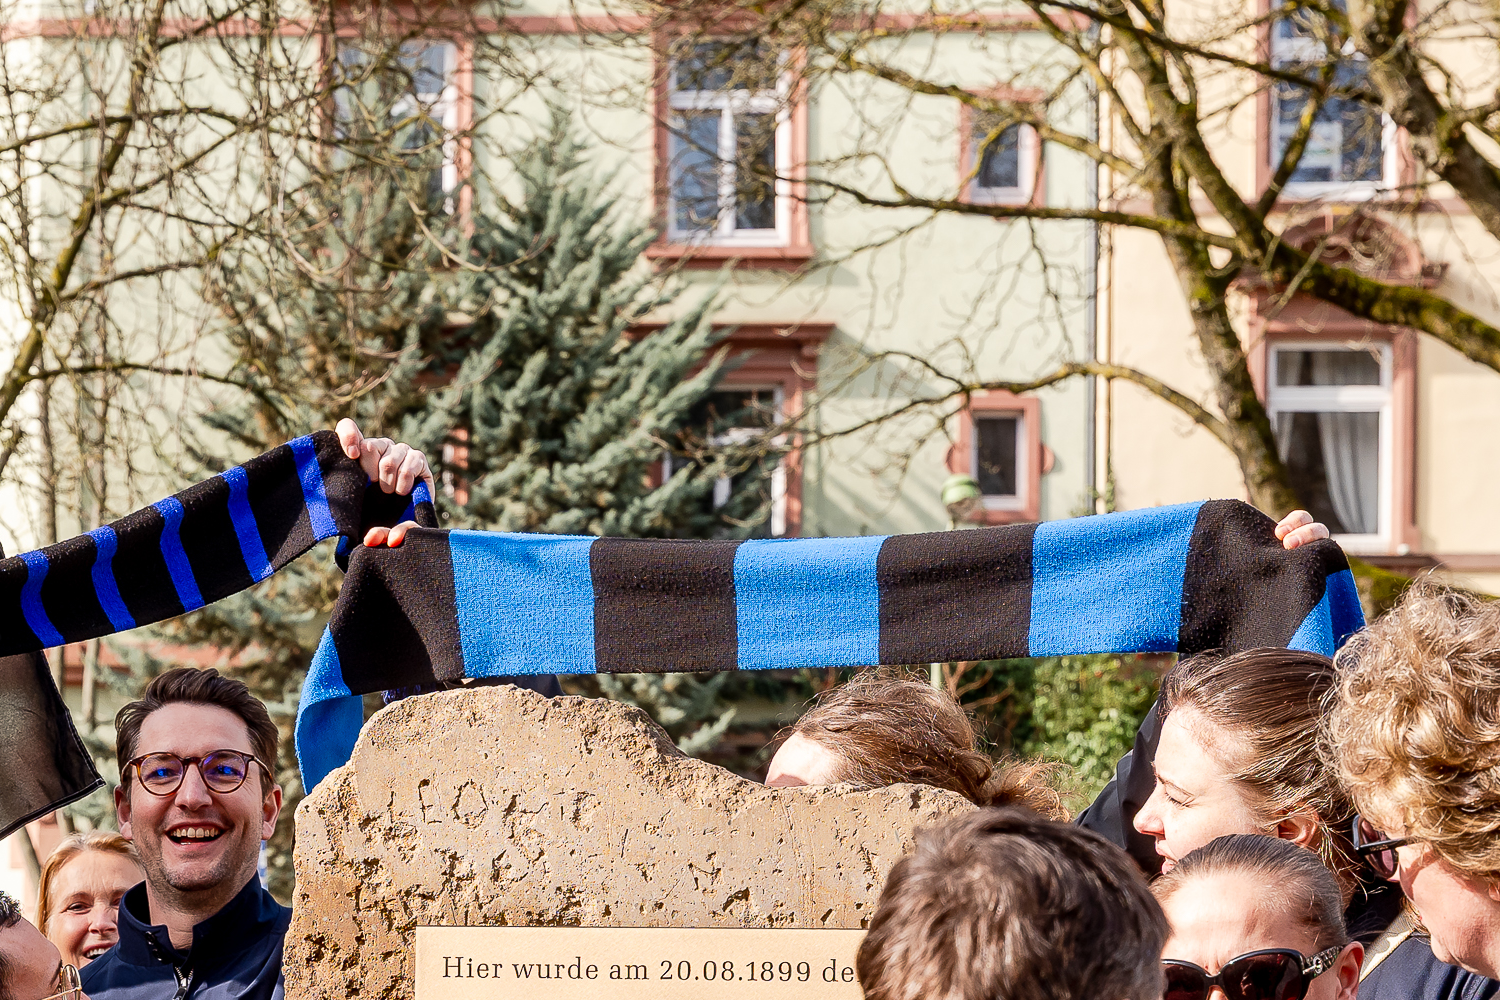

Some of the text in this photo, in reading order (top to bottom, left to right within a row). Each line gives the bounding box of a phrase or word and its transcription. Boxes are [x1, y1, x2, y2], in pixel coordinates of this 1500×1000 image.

[442, 956, 860, 983] Hier wurde am 20.08.1899 de
